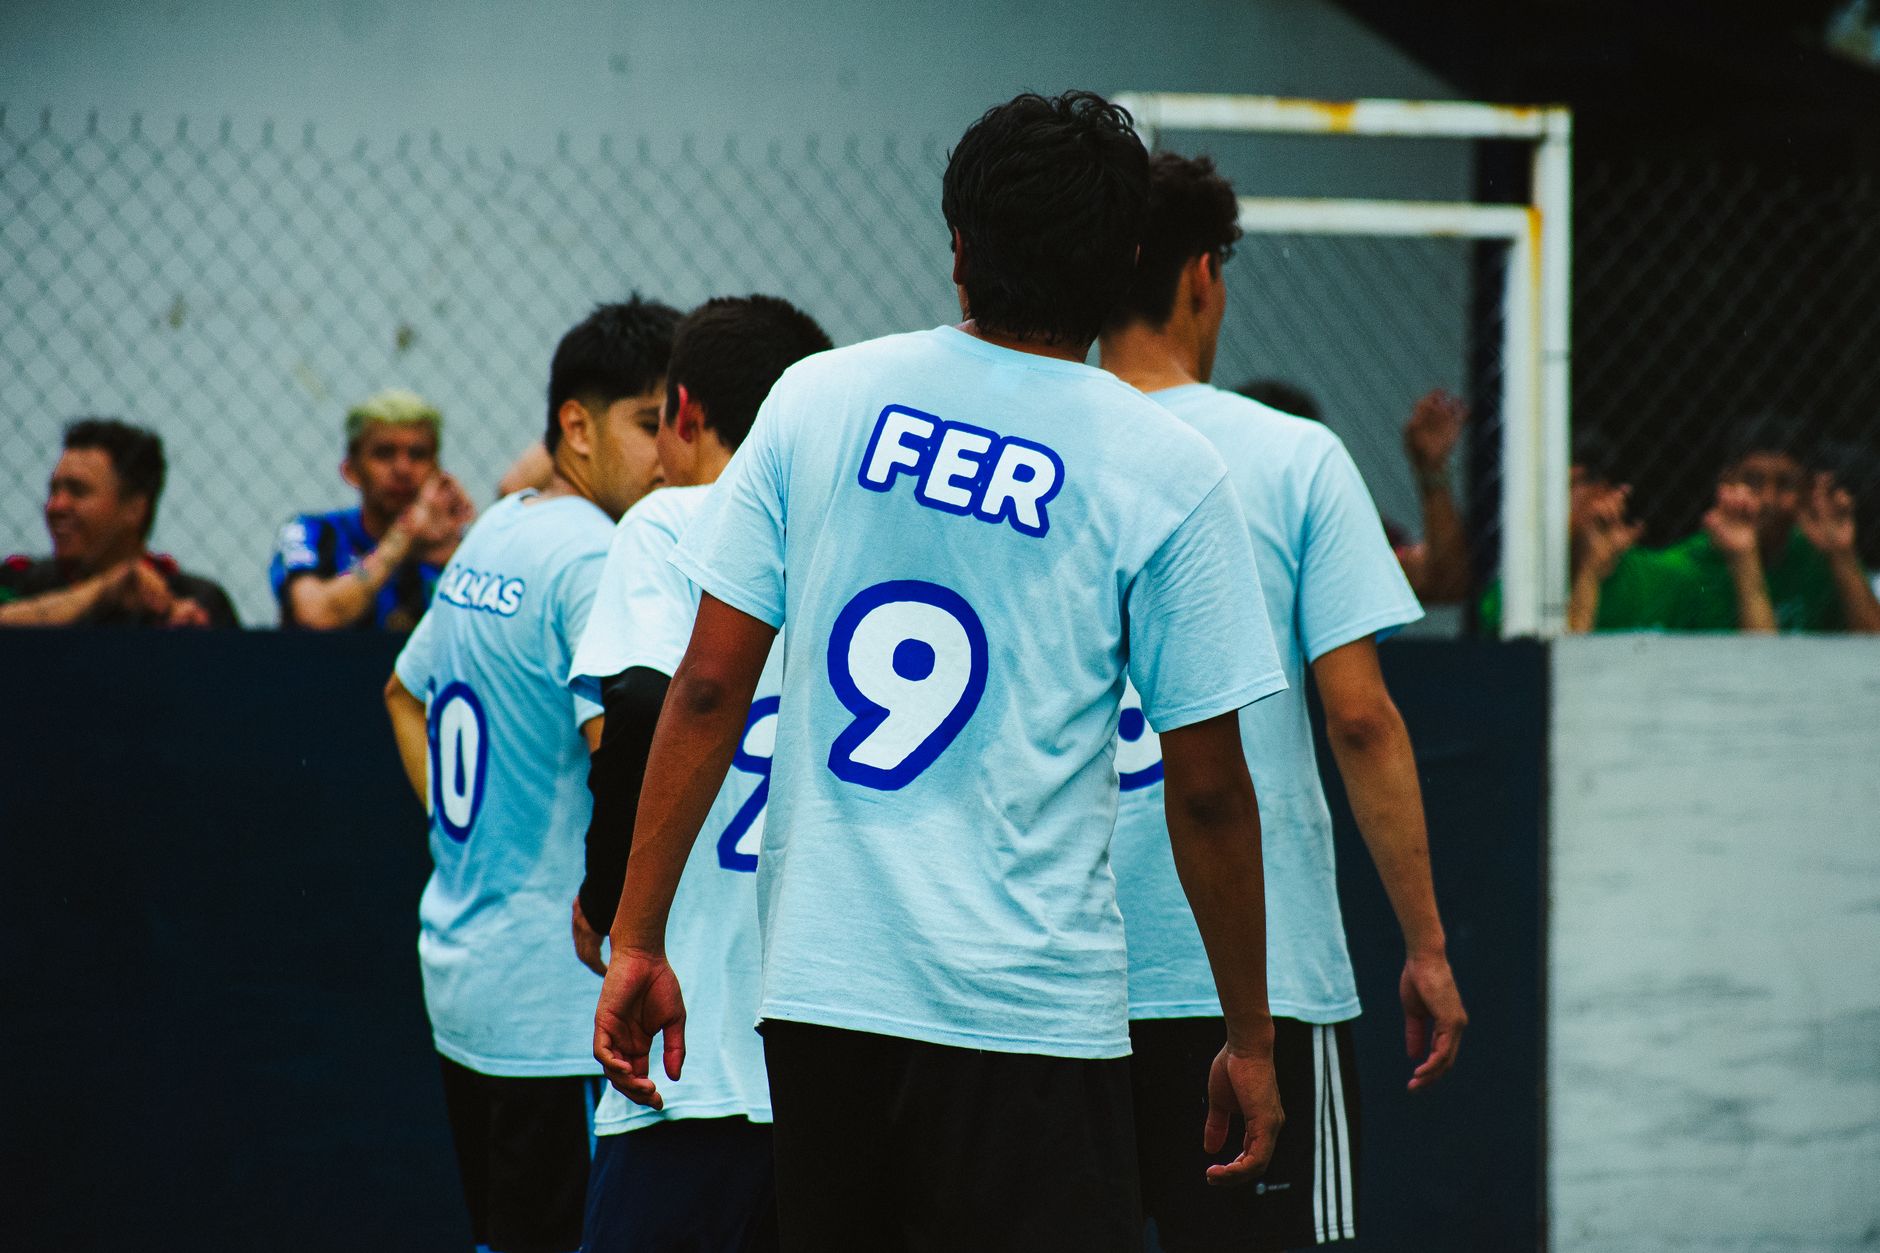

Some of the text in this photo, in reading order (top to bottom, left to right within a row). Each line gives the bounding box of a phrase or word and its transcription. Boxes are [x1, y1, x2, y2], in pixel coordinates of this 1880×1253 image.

[858, 404, 1065, 538] FER
[426, 676, 489, 844] 0
[827, 579, 989, 791] 9
